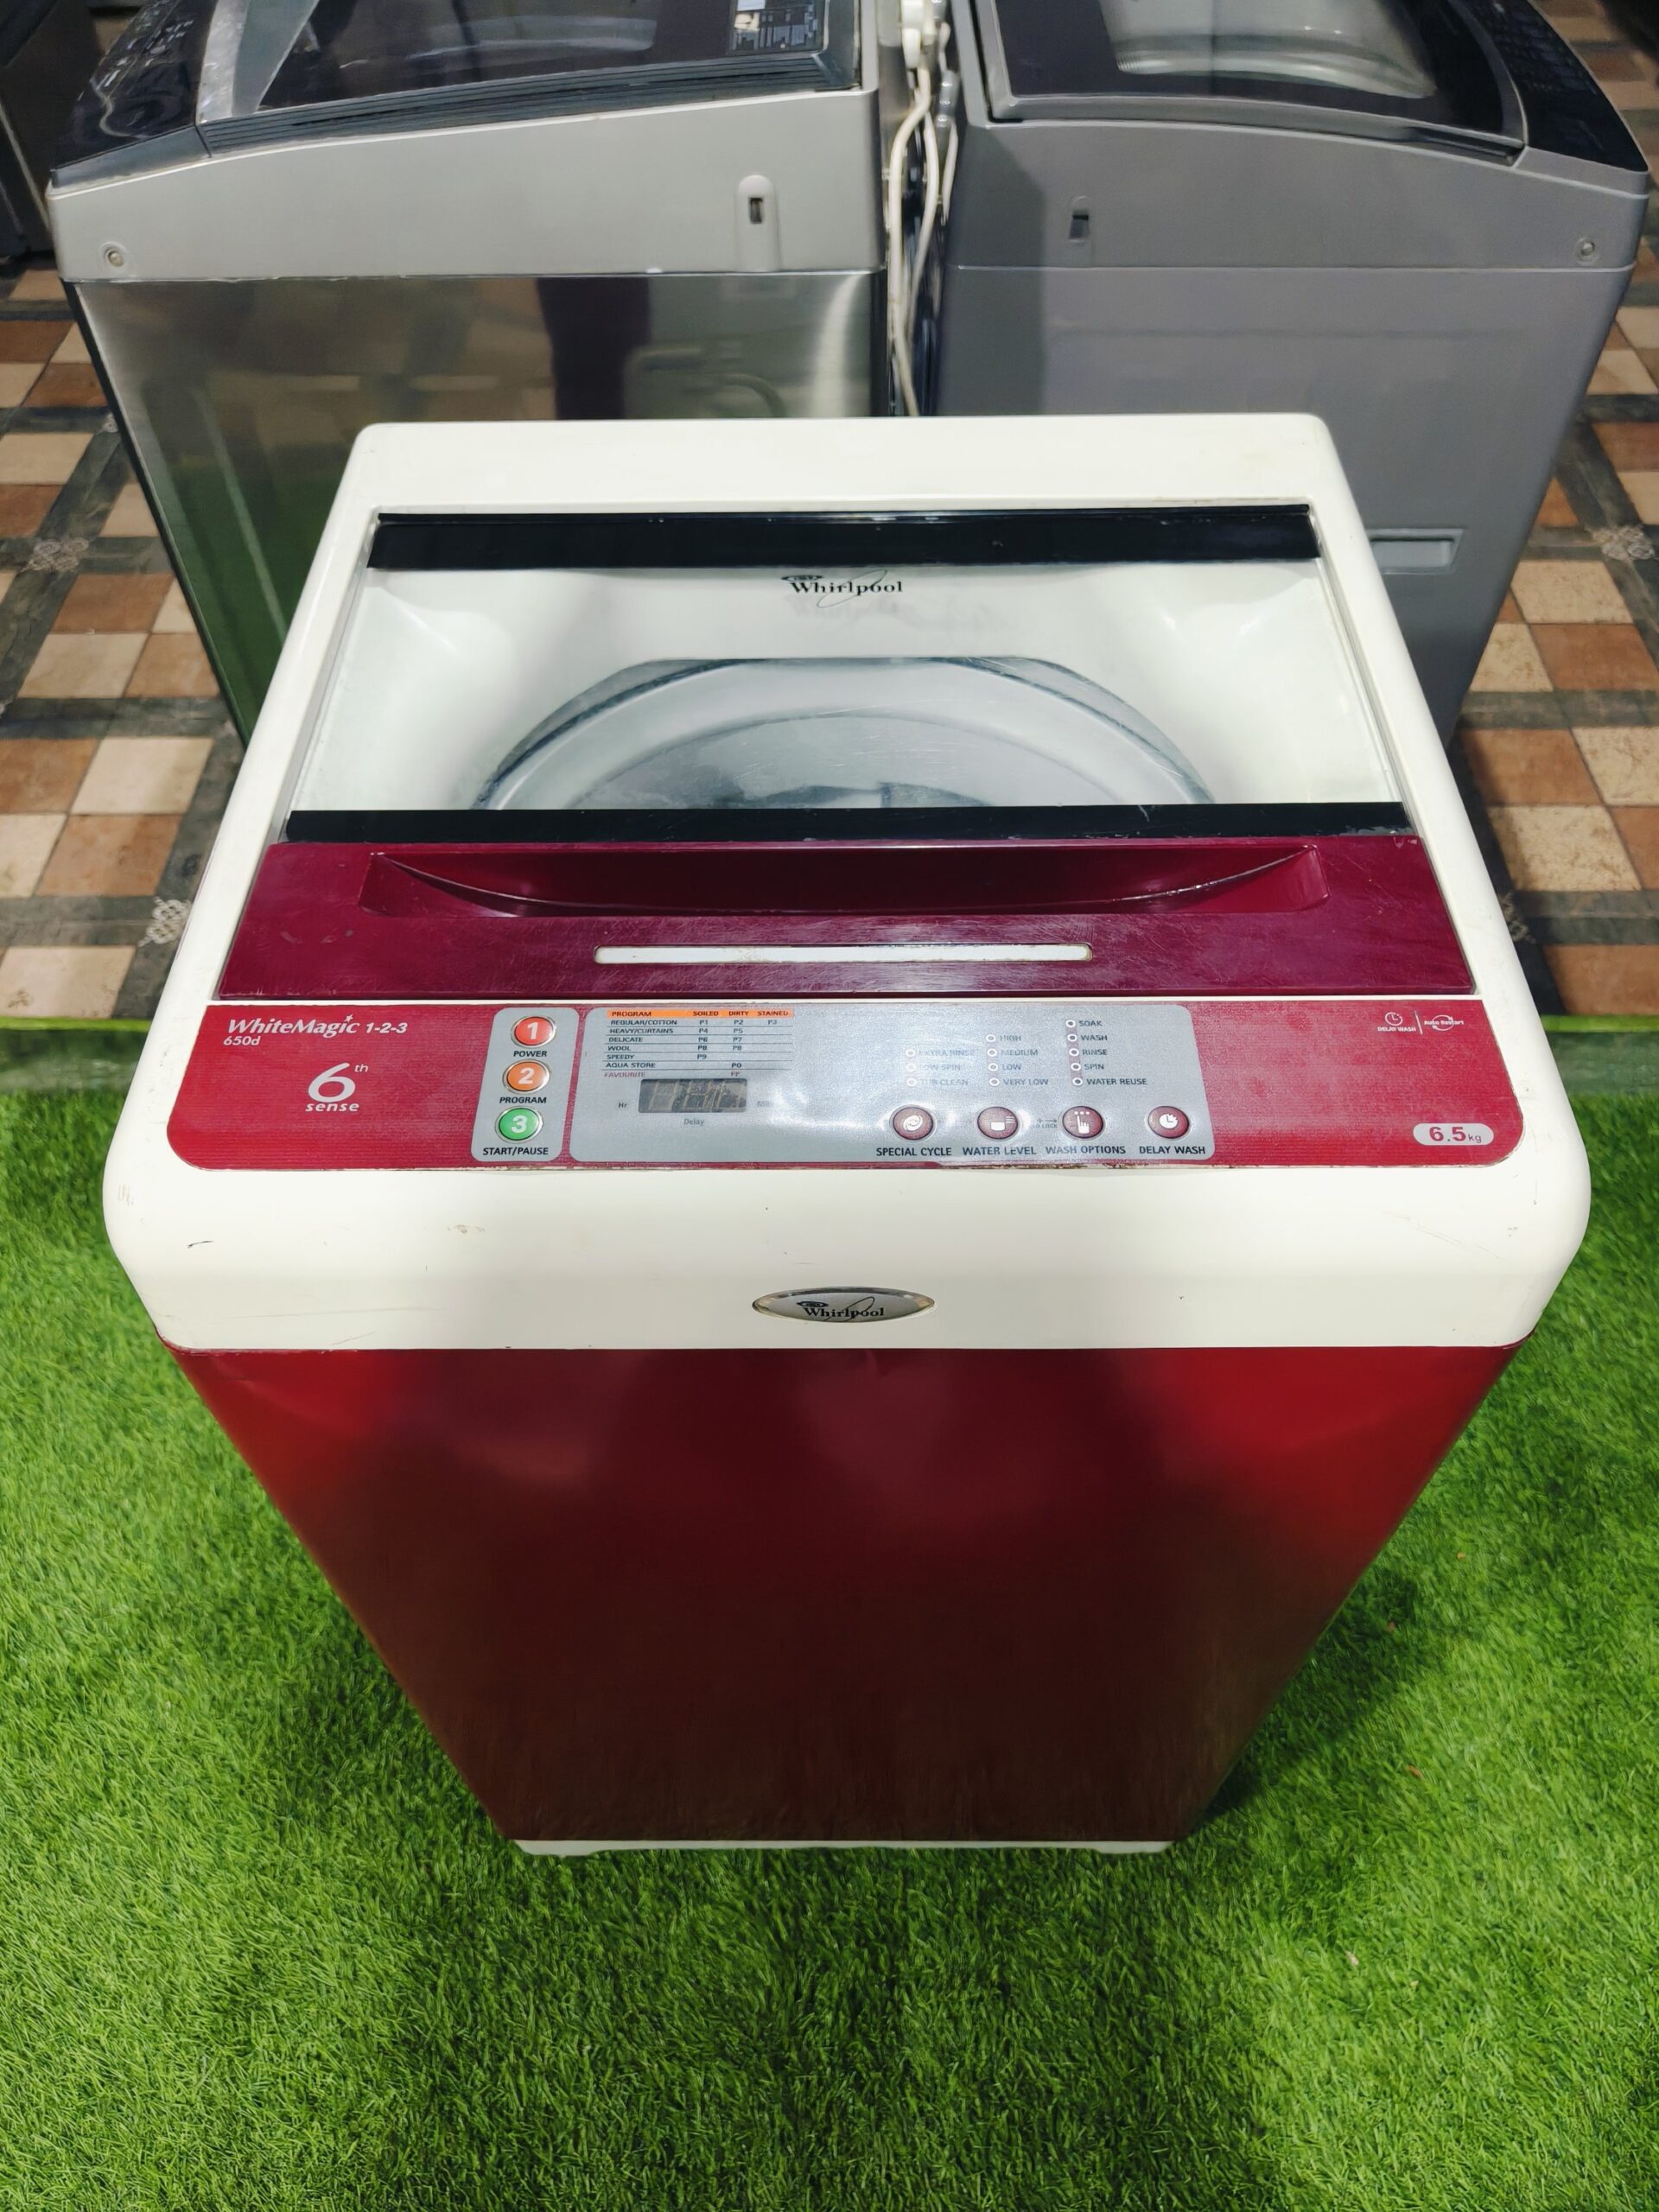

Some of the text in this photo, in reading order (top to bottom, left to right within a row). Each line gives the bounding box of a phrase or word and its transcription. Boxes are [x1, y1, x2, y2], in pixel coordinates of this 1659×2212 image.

[790, 579, 903, 596] Whirlpool
[227, 1015, 408, 1038] WhiteMagic 1-2-3
[527, 1021, 538, 1039] 1
[223, 1035, 261, 1046] 650d
[518, 1067, 535, 1084] 2
[305, 1102, 359, 1112] sense
[511, 1115, 527, 1134] 3
[1429, 1126, 1482, 1143] 6.5 kg
[483, 1147, 549, 1156] START/PAUSE
[876, 1147, 951, 1156] SPECIAL CYCLE
[963, 1147, 1037, 1155] WATER LEVEL
[1046, 1146, 1126, 1154] WASH OPTIONS
[1139, 1146, 1206, 1154] DELAY WASH
[804, 1306, 885, 1319] Whirlpool
